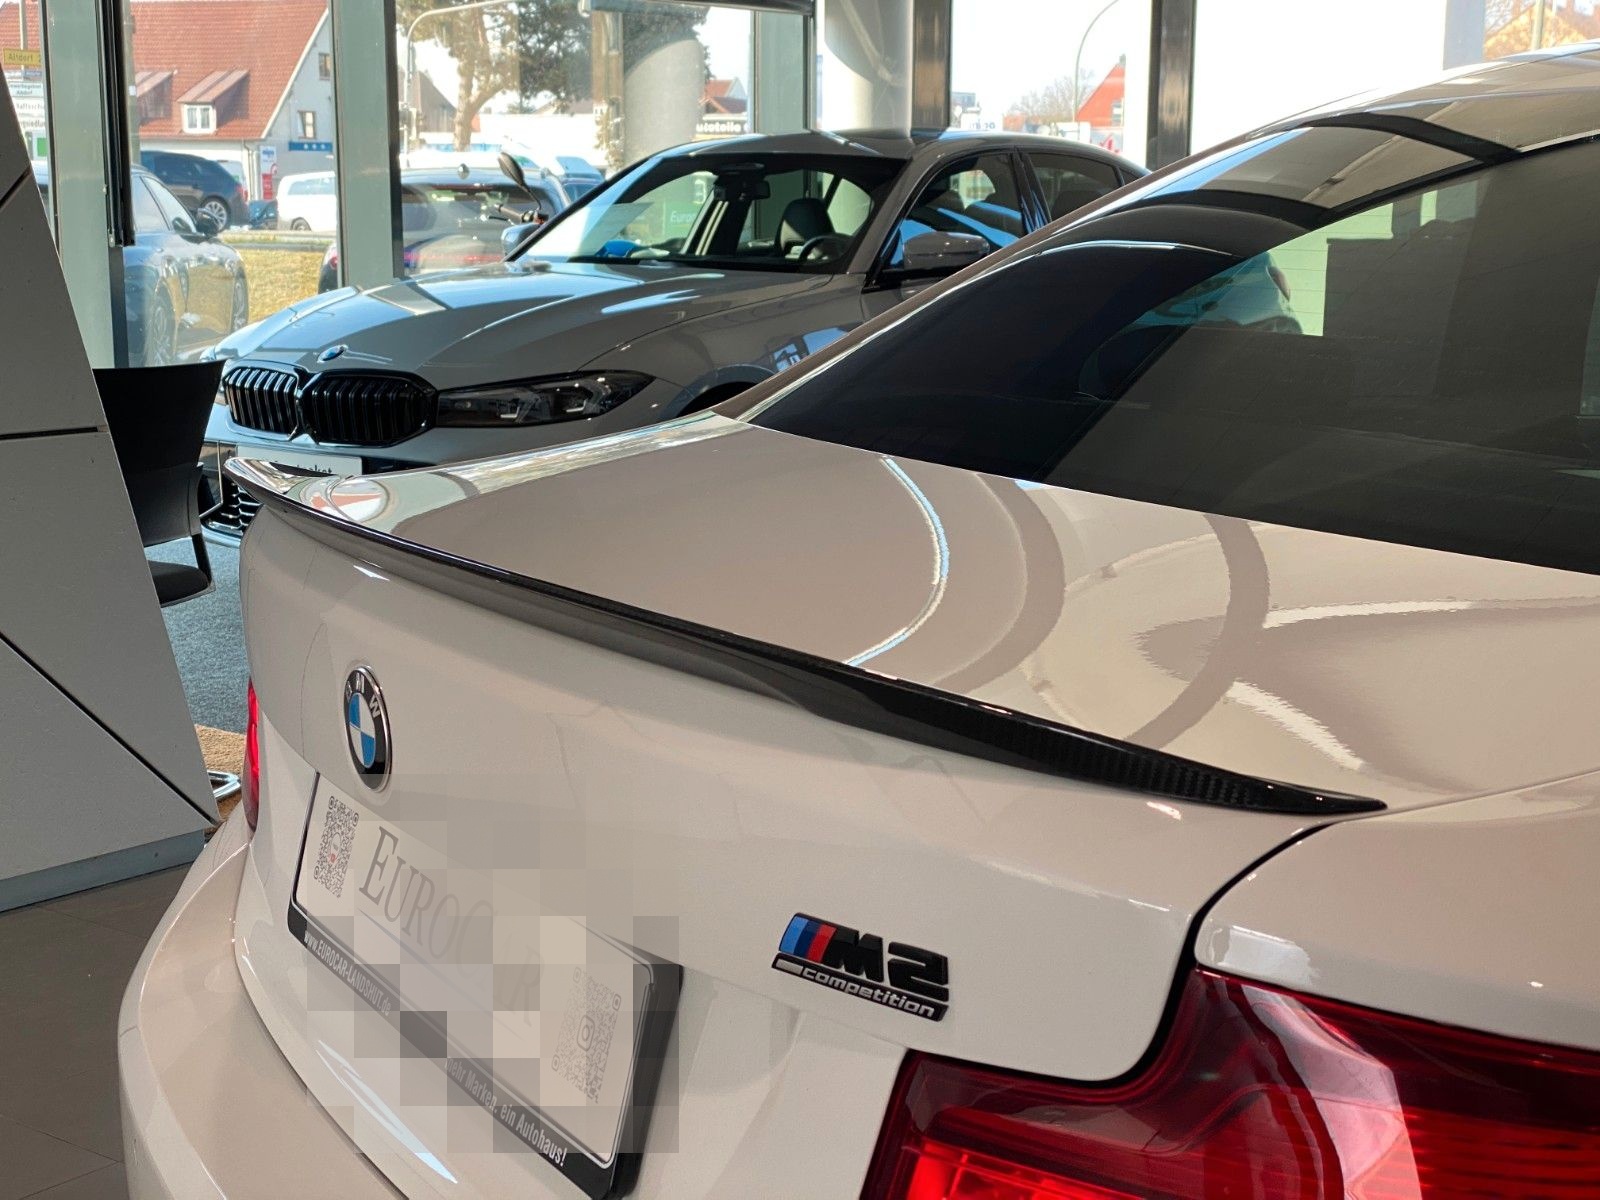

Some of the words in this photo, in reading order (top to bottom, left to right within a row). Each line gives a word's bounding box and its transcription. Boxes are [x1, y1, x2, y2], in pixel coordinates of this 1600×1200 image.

[8, 53, 34, 61] Altdorf
[695, 121, 742, 133] utoteile
[820, 917, 950, 1002] M2
[801, 966, 935, 1019] competition
[500, 1103, 517, 1128] ein
[515, 1113, 568, 1168] Autohaus!
